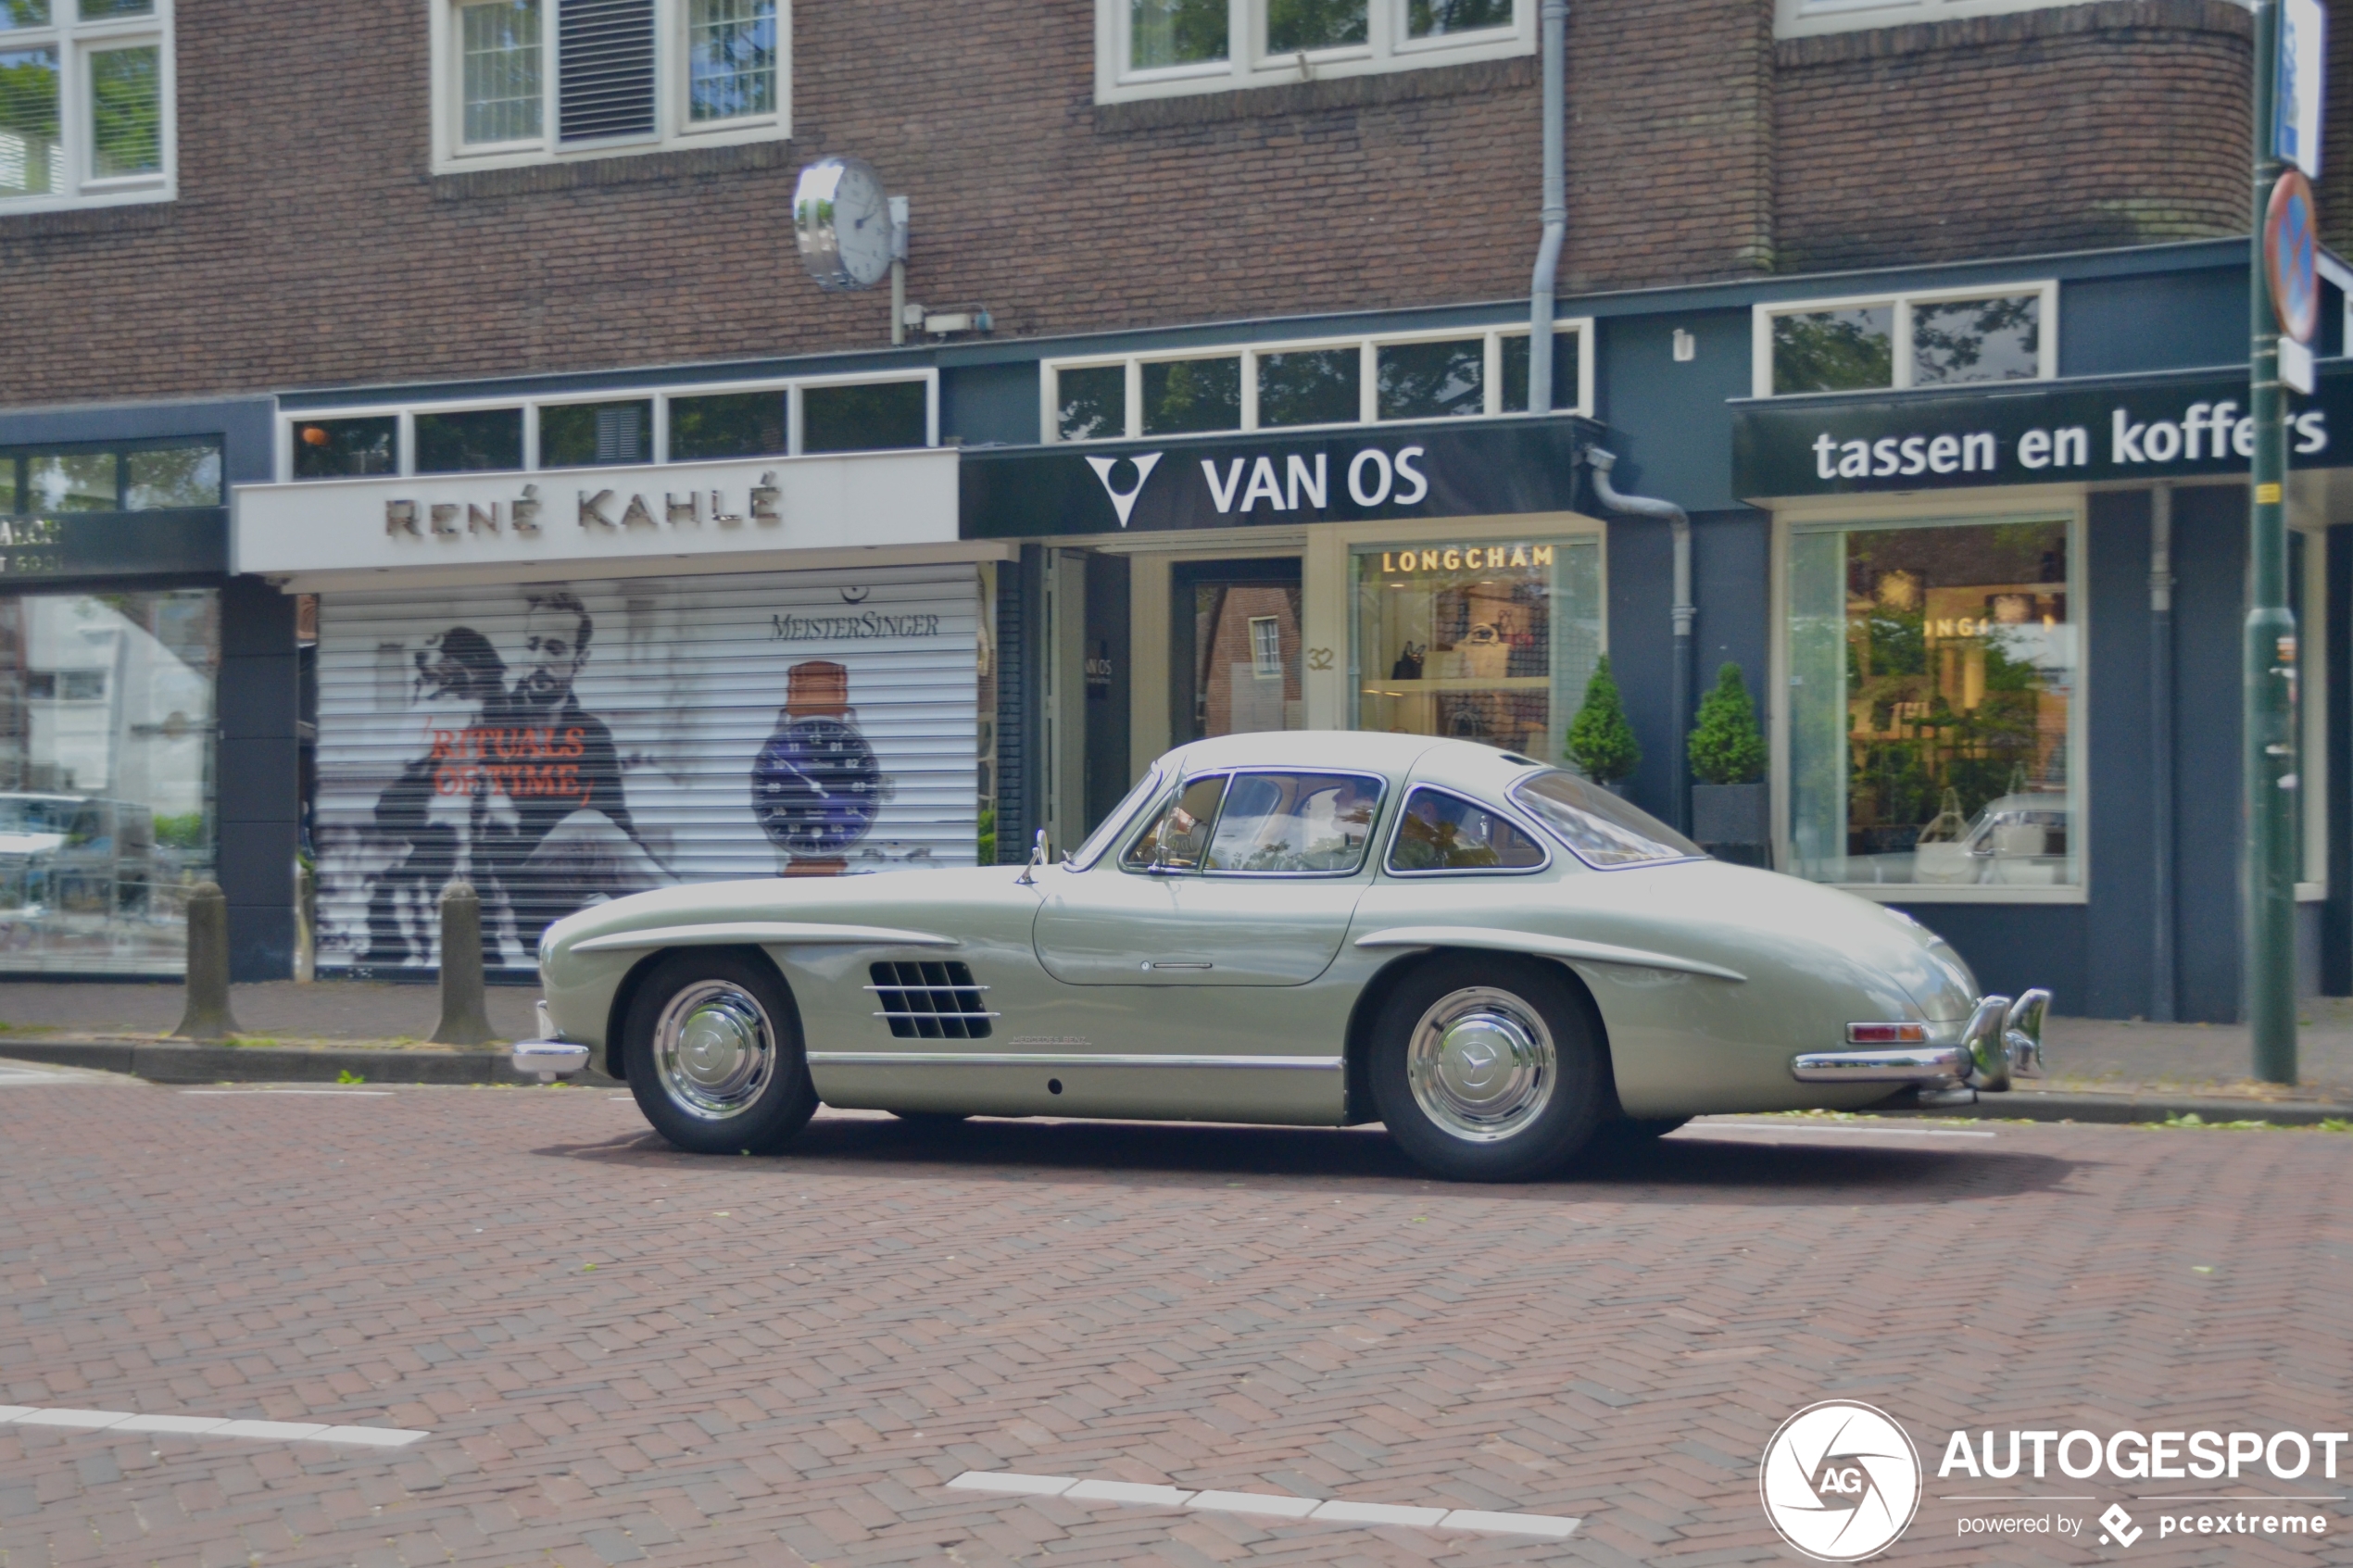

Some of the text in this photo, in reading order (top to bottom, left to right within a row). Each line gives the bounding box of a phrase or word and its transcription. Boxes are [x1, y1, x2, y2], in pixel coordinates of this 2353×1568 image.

[1812, 432, 1996, 480] tassen
[2018, 425, 2087, 469] en
[1201, 445, 1428, 513] VAN OS
[1382, 545, 1554, 572] LONGCHAM
[1307, 647, 1334, 671] 32
[431, 726, 585, 759] RITUALS
[433, 764, 582, 796] OF TIME
[1063, 1035, 1087, 1044] BENZ
